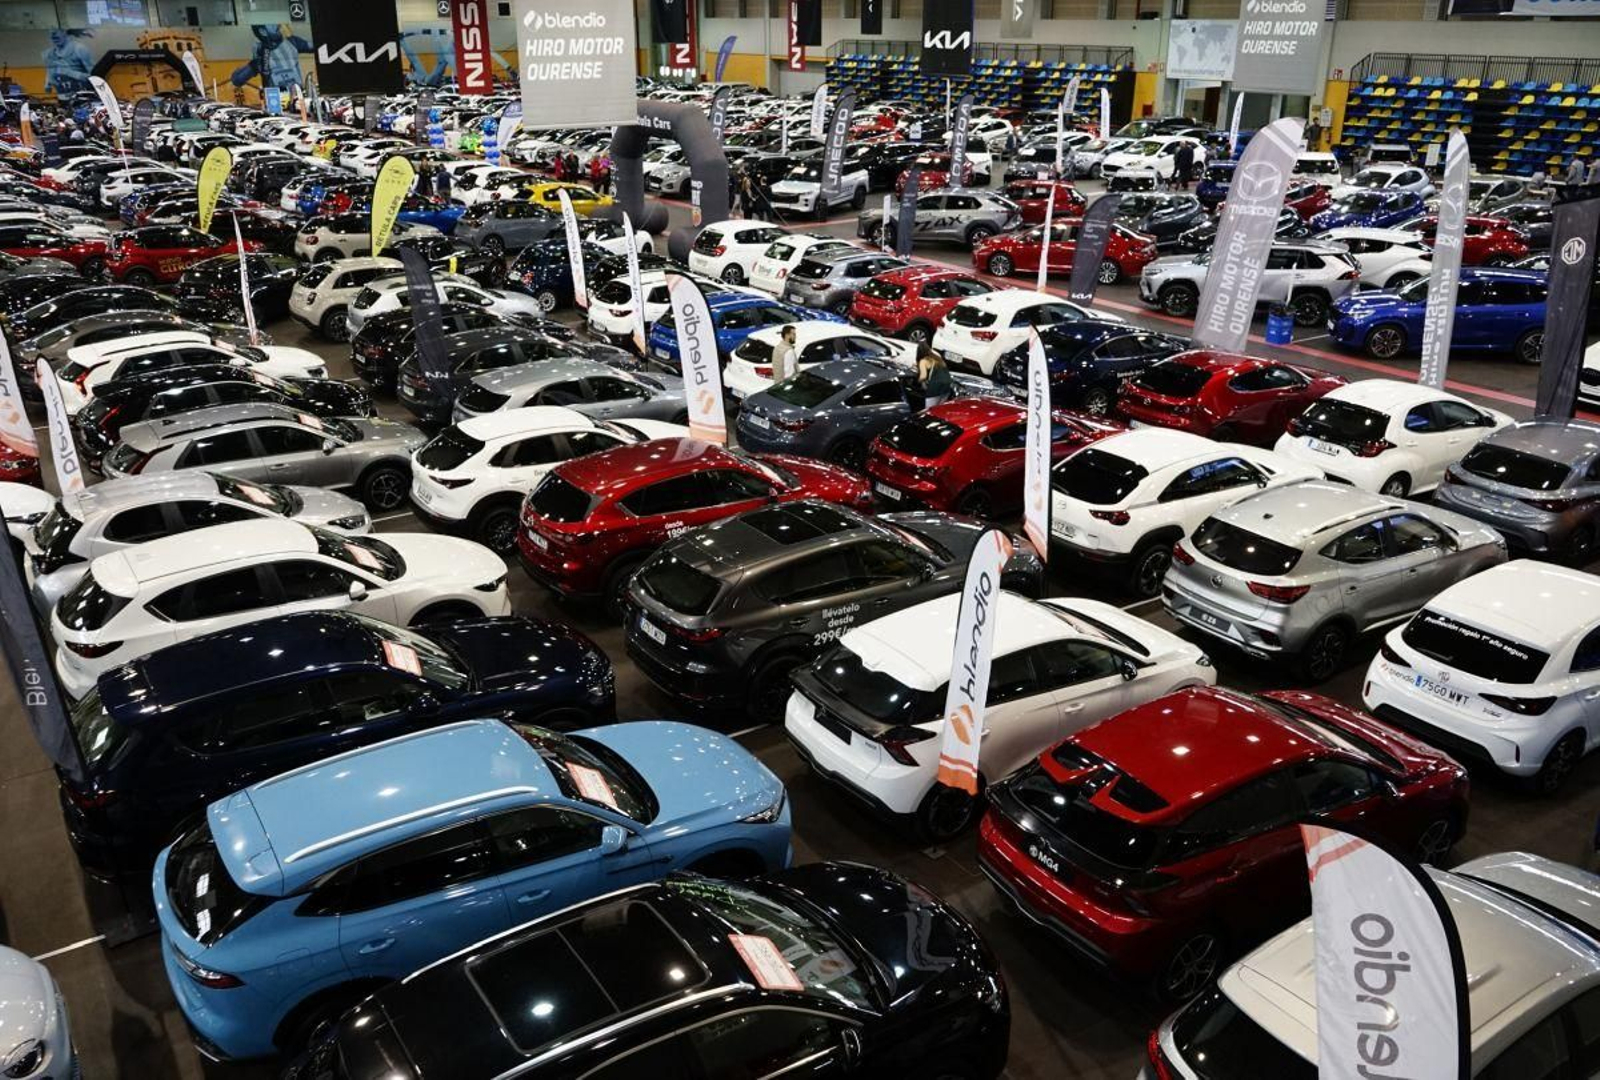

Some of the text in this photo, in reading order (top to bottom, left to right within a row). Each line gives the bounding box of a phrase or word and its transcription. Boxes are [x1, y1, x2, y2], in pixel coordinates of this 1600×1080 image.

[1260, 1, 1306, 13] blendio
[544, 12, 606, 28] blendio
[1243, 21, 1318, 36] HIRO MOTOR
[460, 0, 485, 87] NISS
[526, 37, 624, 57] HIRO MOTOR
[924, 30, 971, 50] KIA
[1241, 40, 1297, 55] OURENSE
[318, 42, 397, 64] KIA
[527, 62, 603, 81] OURENSE
[637, 114, 671, 130] tula Cars
[828, 108, 849, 186] JAECOO
[952, 103, 970, 177] OMODA
[1227, 203, 1278, 217] mazda
[1207, 230, 1248, 334] HIRO MOTOR
[1071, 292, 1093, 300] KIA
[1228, 257, 1260, 336] OURENSE
[821, 602, 861, 620] llévatelo
[827, 614, 855, 629] desde
[959, 570, 993, 703] blendio
[1458, 627, 1481, 640] regalo
[1488, 639, 1504, 649] año
[1502, 644, 1529, 660] seguro
[1037, 850, 1059, 873] MG4
